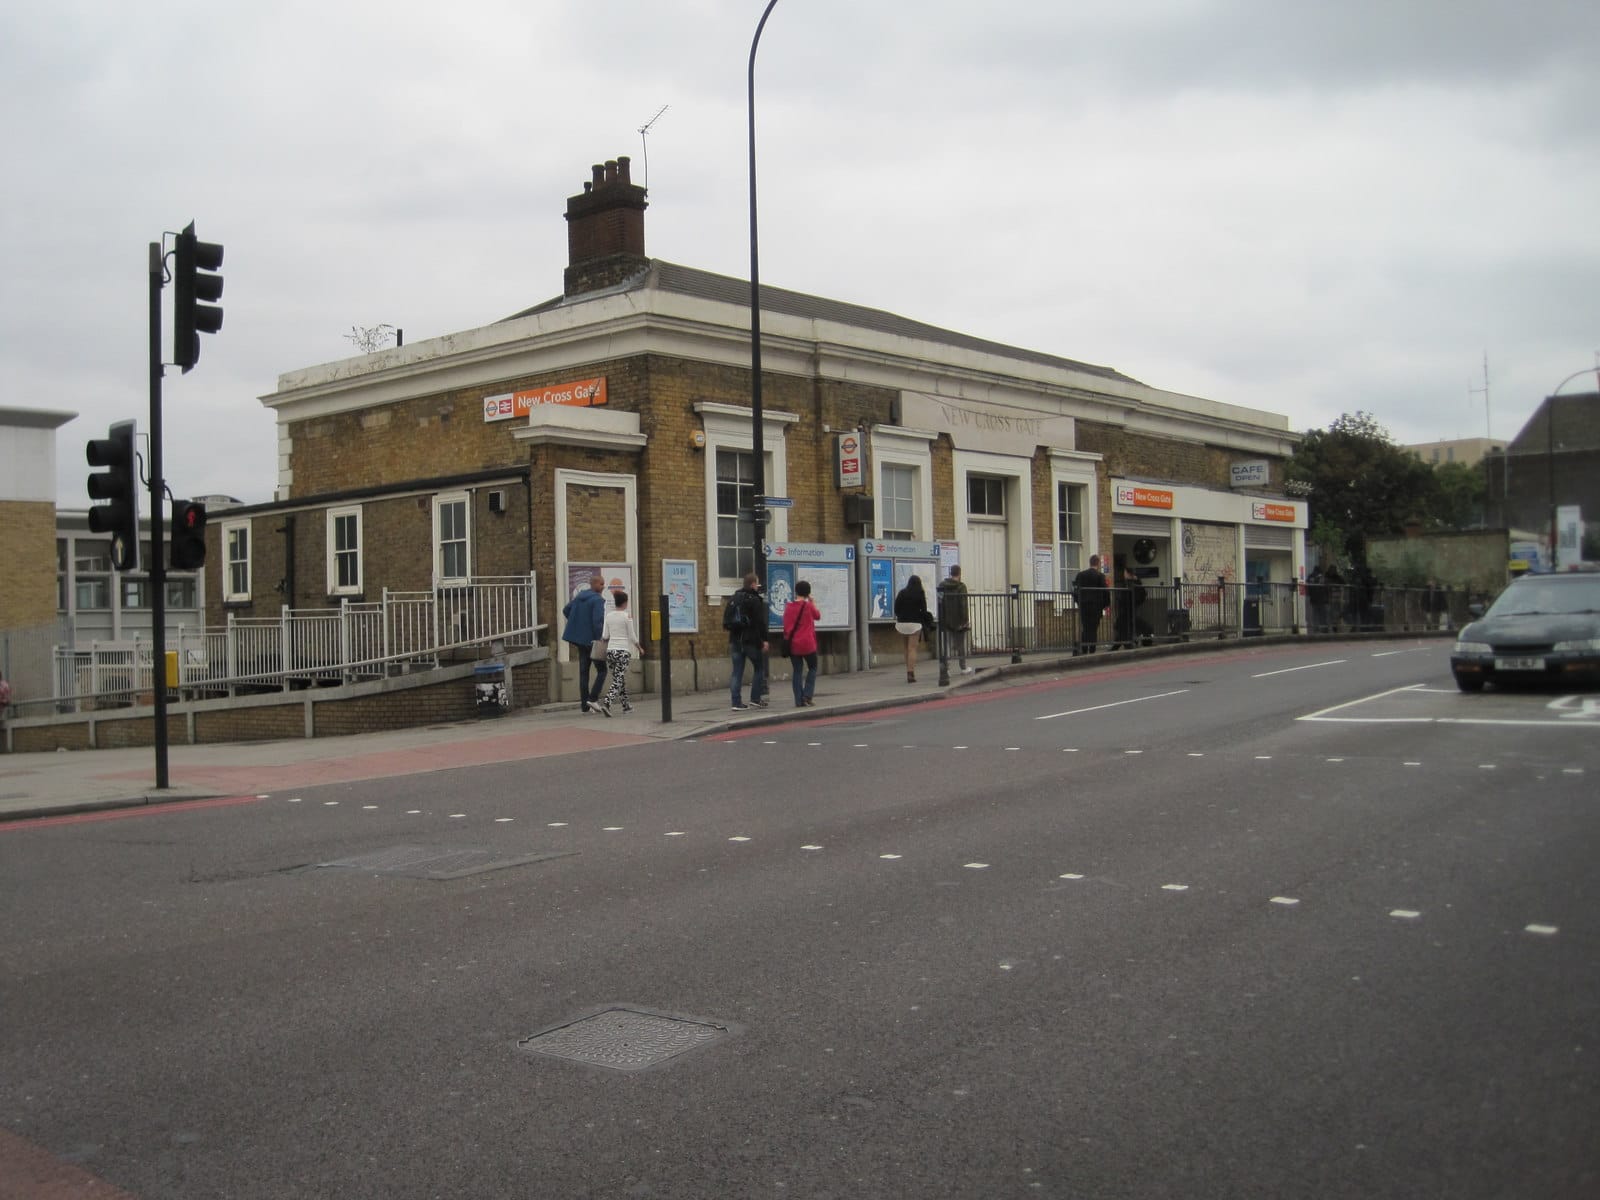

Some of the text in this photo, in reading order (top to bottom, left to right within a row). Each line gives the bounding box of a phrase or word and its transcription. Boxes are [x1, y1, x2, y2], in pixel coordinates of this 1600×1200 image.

[518, 396, 541, 408] New
[543, 391, 572, 404] Cross
[941, 406, 1041, 437] NEW CROSS GATE
[1232, 465, 1265, 474] CAFE
[788, 547, 825, 557] Information
[886, 545, 916, 553] Information
